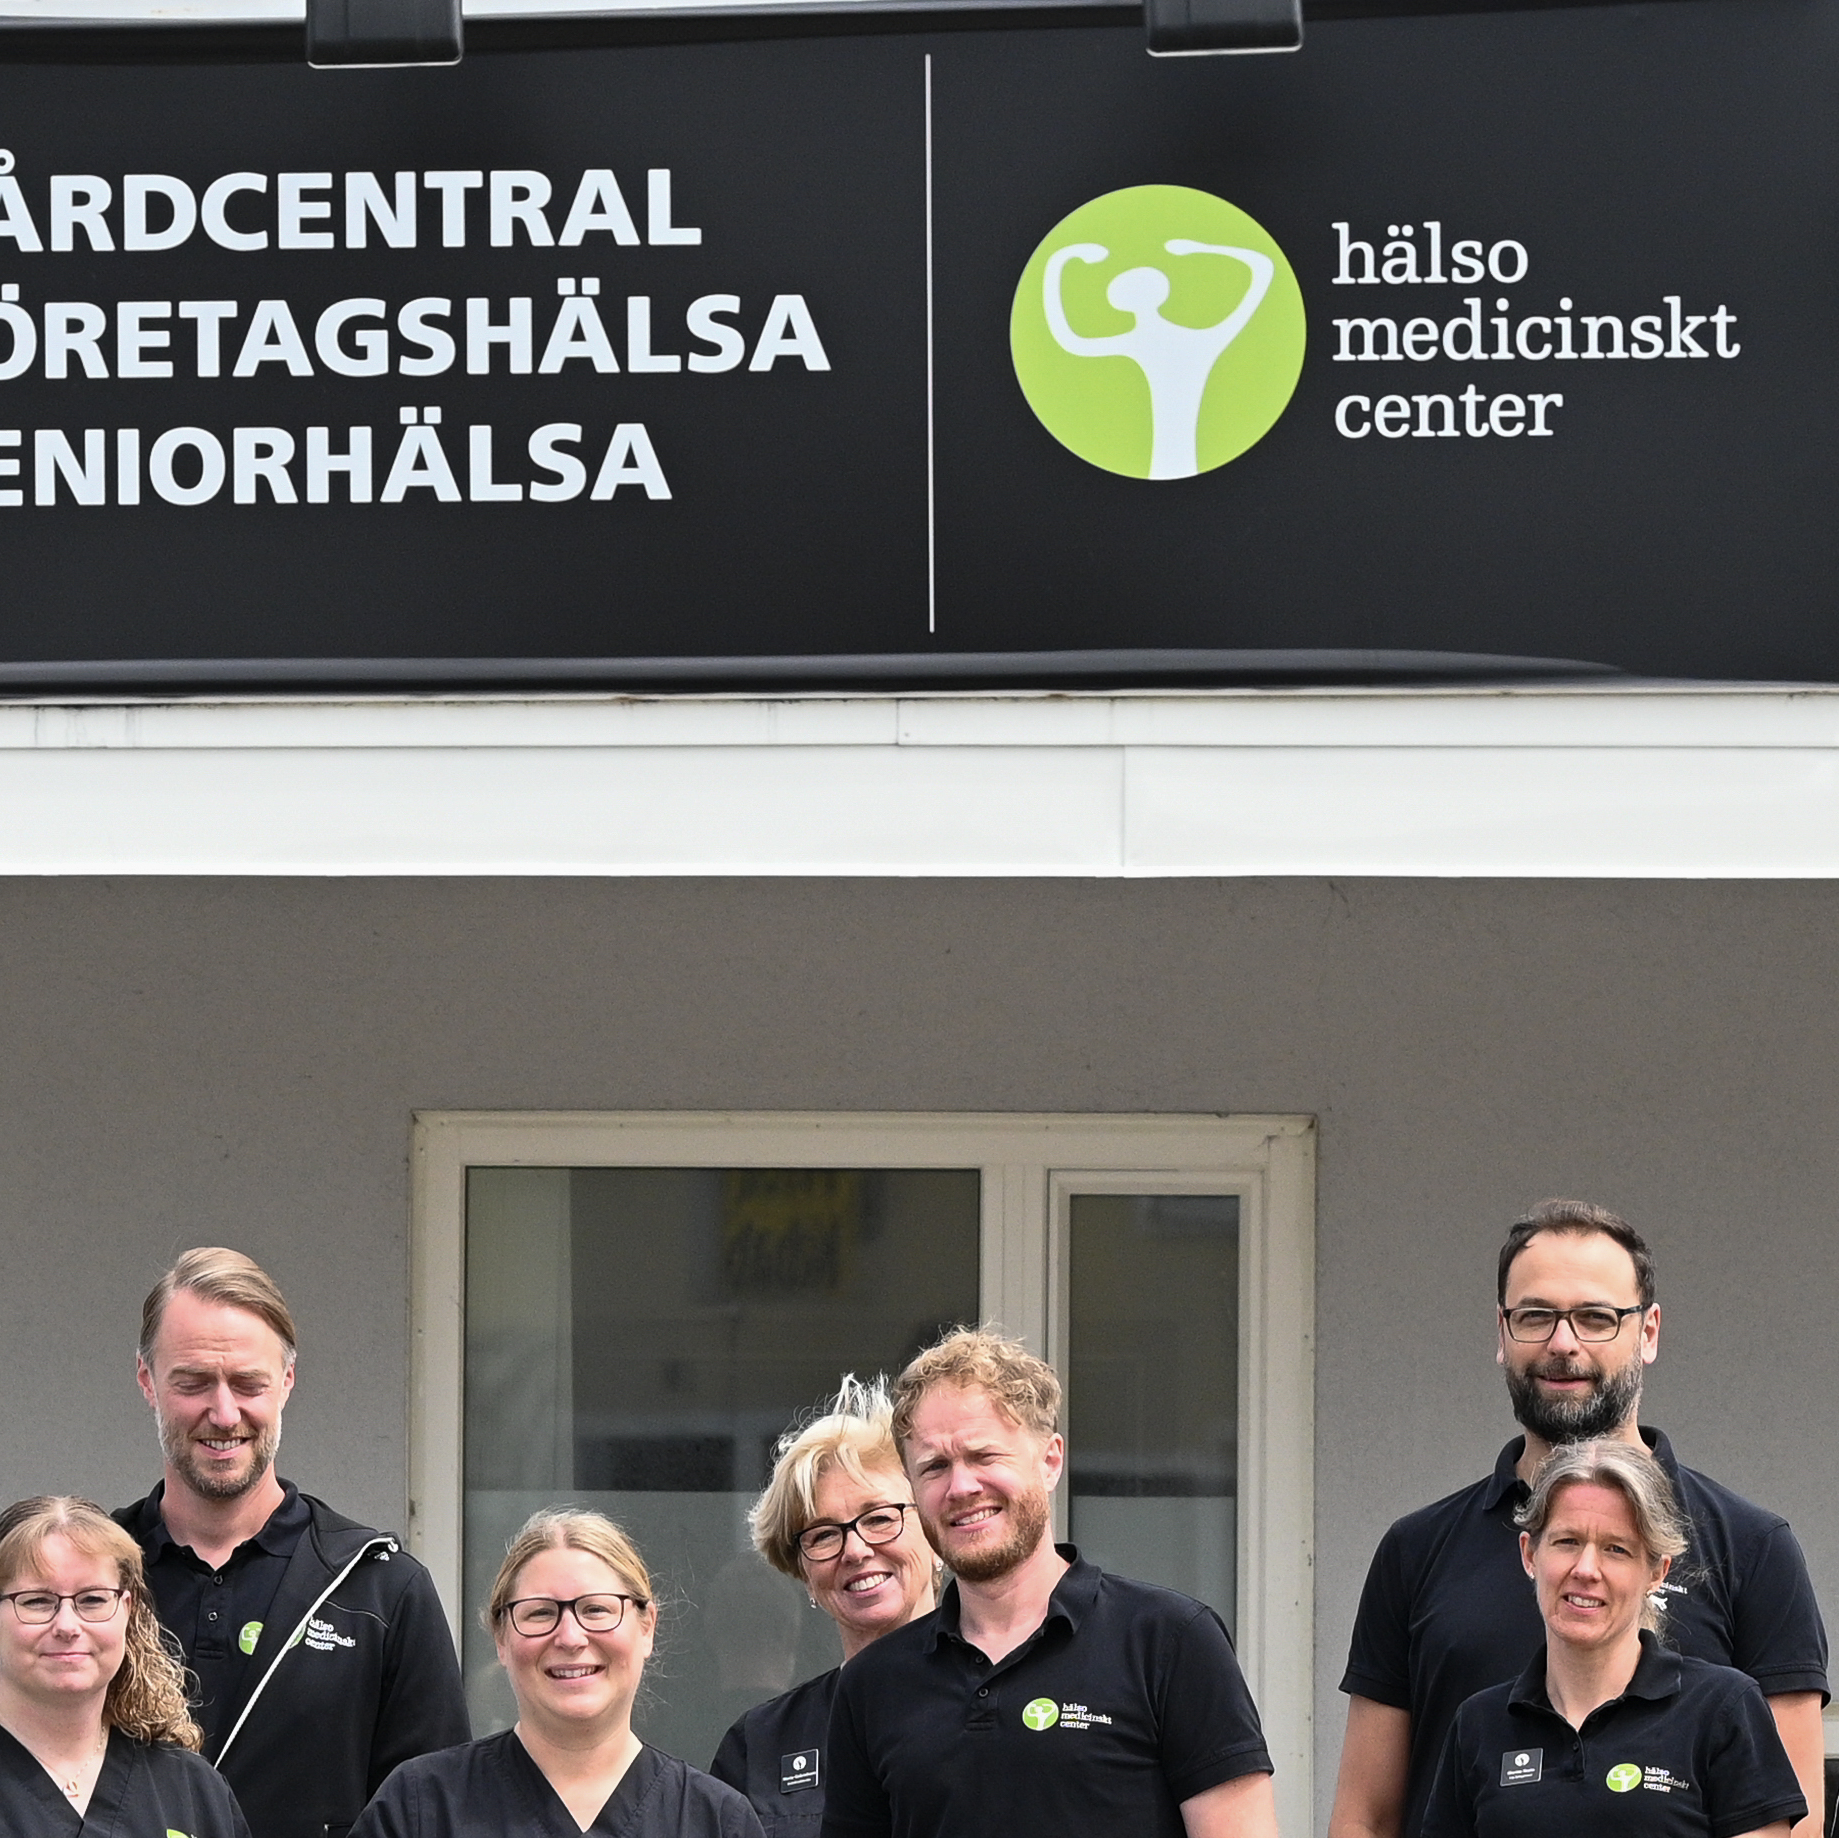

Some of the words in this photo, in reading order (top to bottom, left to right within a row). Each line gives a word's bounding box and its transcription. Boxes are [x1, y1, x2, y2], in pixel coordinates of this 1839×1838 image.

[1332, 221, 1528, 284] hälso
[1332, 296, 1740, 361] medicinskt
[1335, 384, 1563, 438] center
[1062, 1703, 1087, 1712] hälso
[1061, 1712, 1112, 1725] medicinskt
[1060, 1721, 1090, 1730] center
[1645, 1766, 1670, 1776] hälso
[1643, 1782, 1671, 1793] center
[1644, 1774, 1689, 1790] medicinskt
